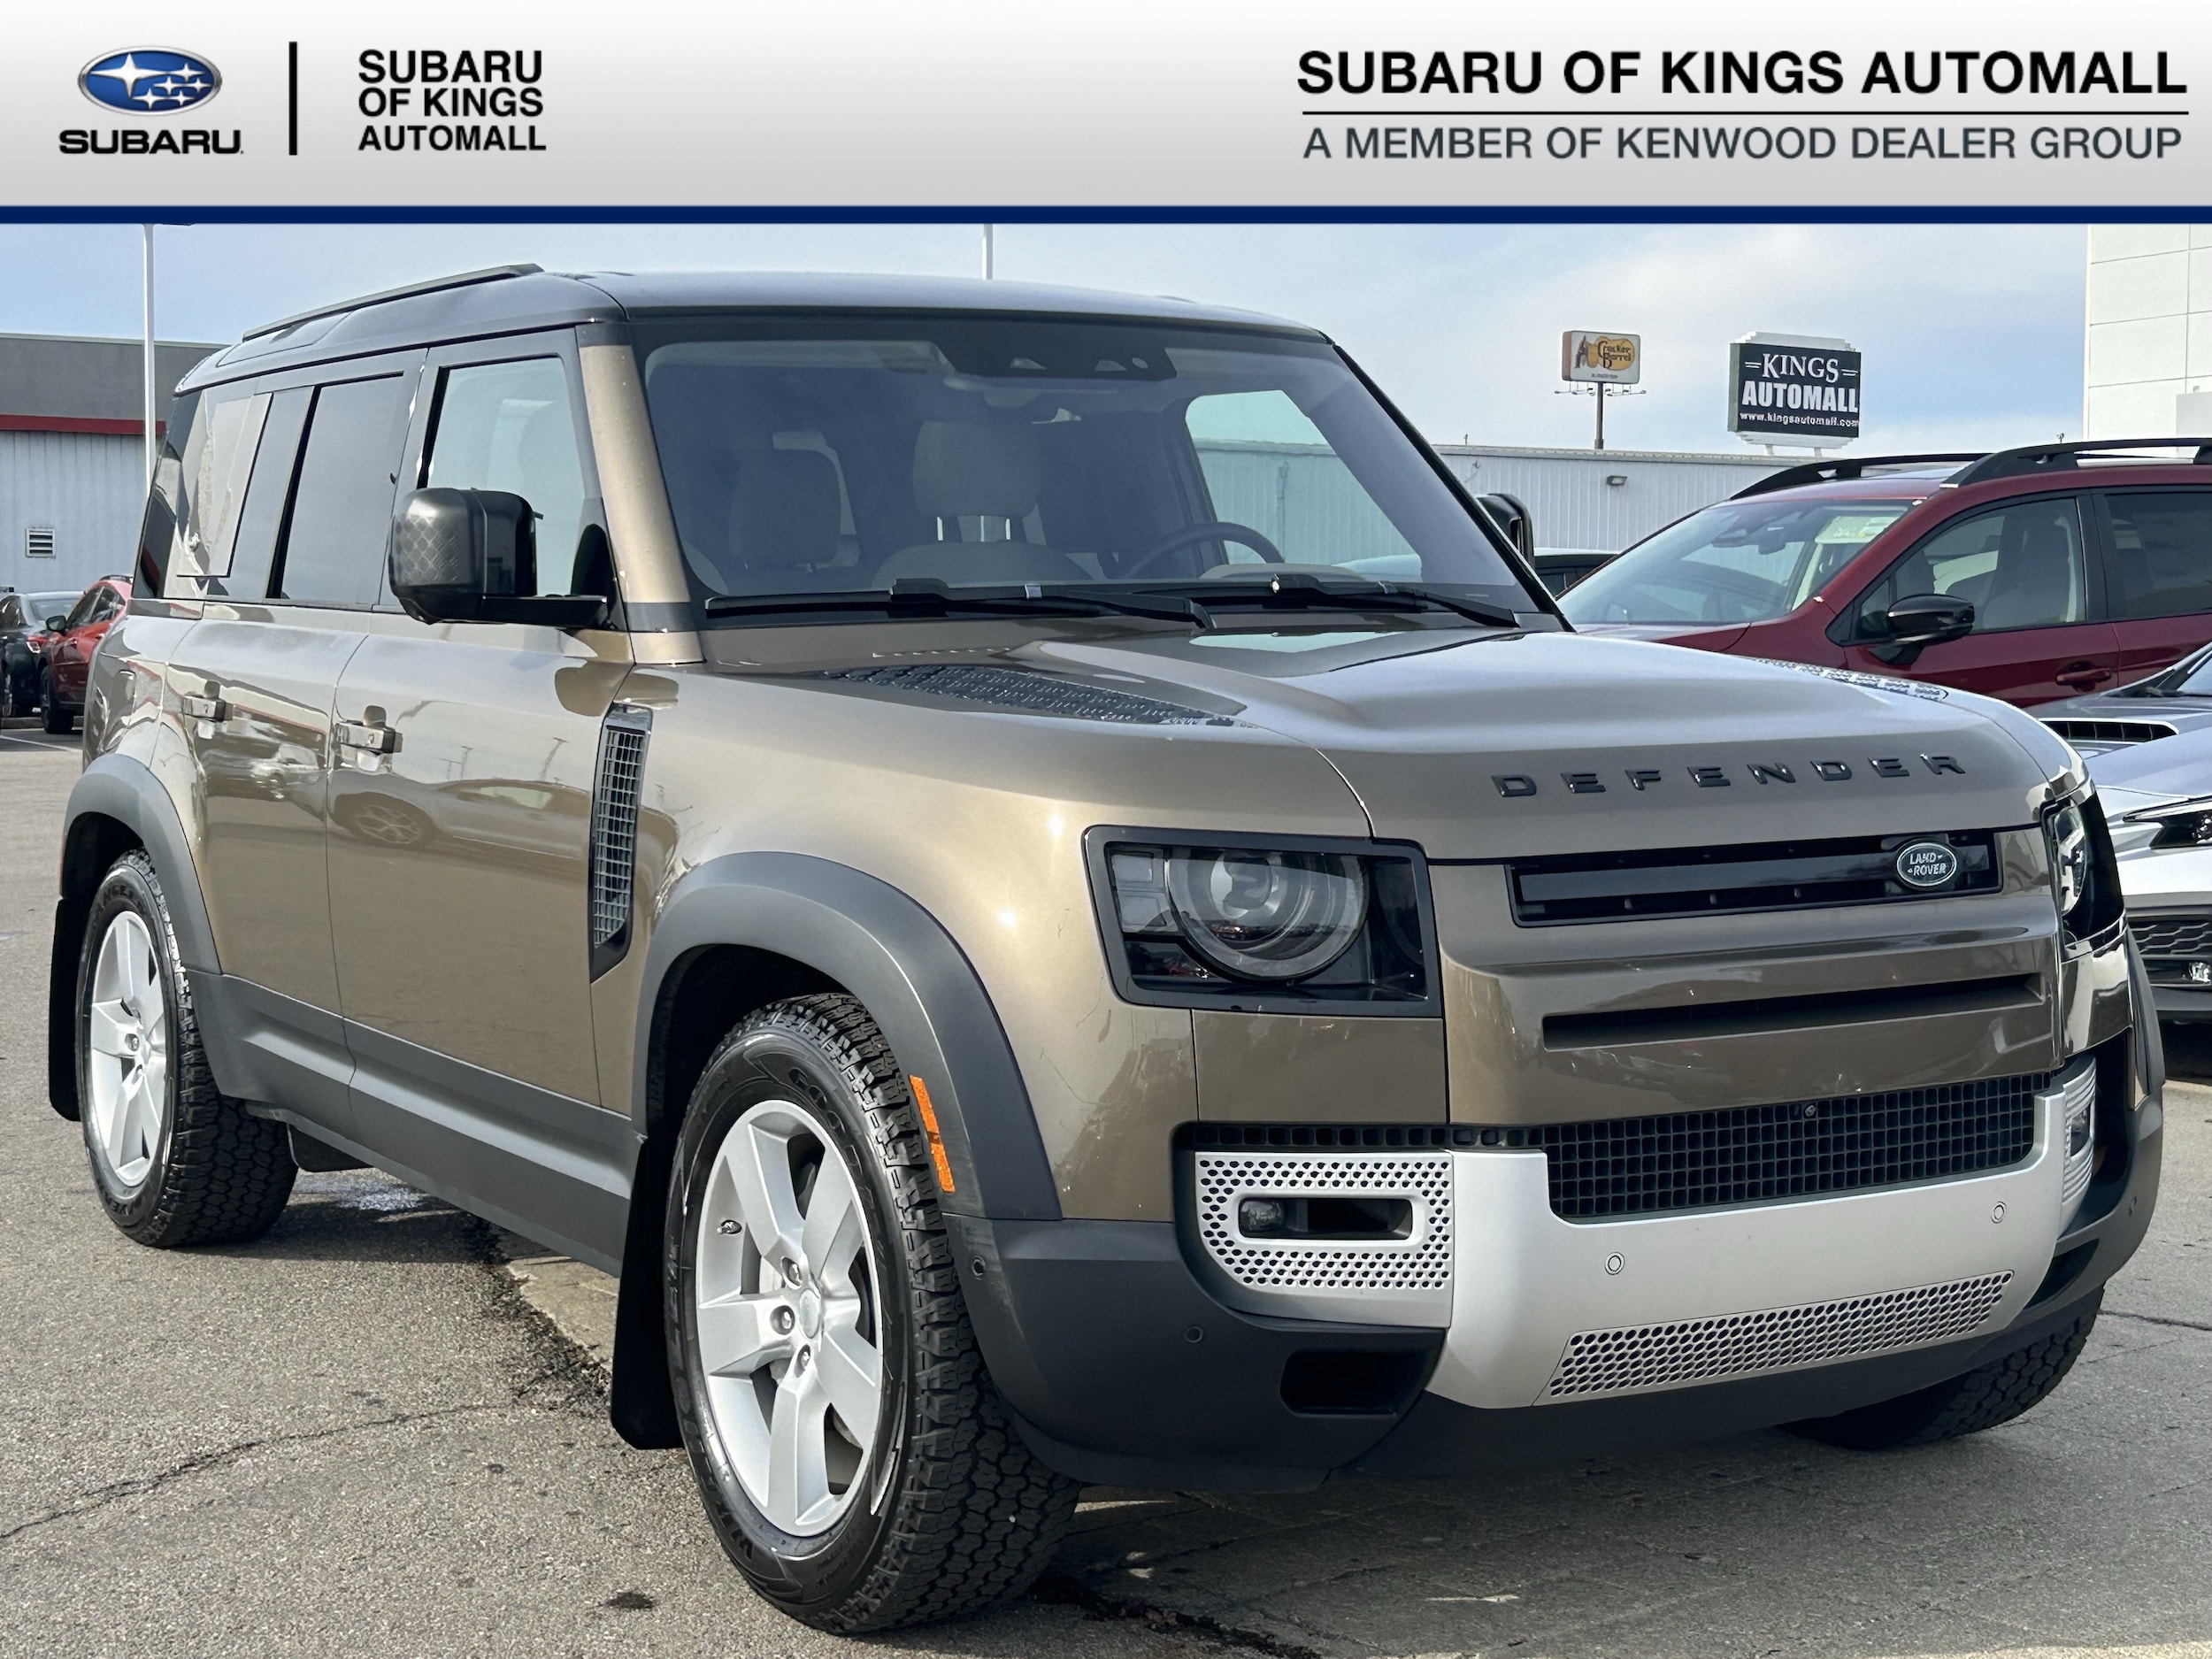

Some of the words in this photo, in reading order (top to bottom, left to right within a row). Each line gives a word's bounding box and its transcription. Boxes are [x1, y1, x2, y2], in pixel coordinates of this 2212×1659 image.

[1762, 353, 1839, 383] KINGS
[1741, 380, 1859, 413] AUTOMALL
[1490, 752, 1966, 798] DEFENDER
[1909, 852, 1936, 865] LAND
[1913, 863, 1947, 876] ROVER
